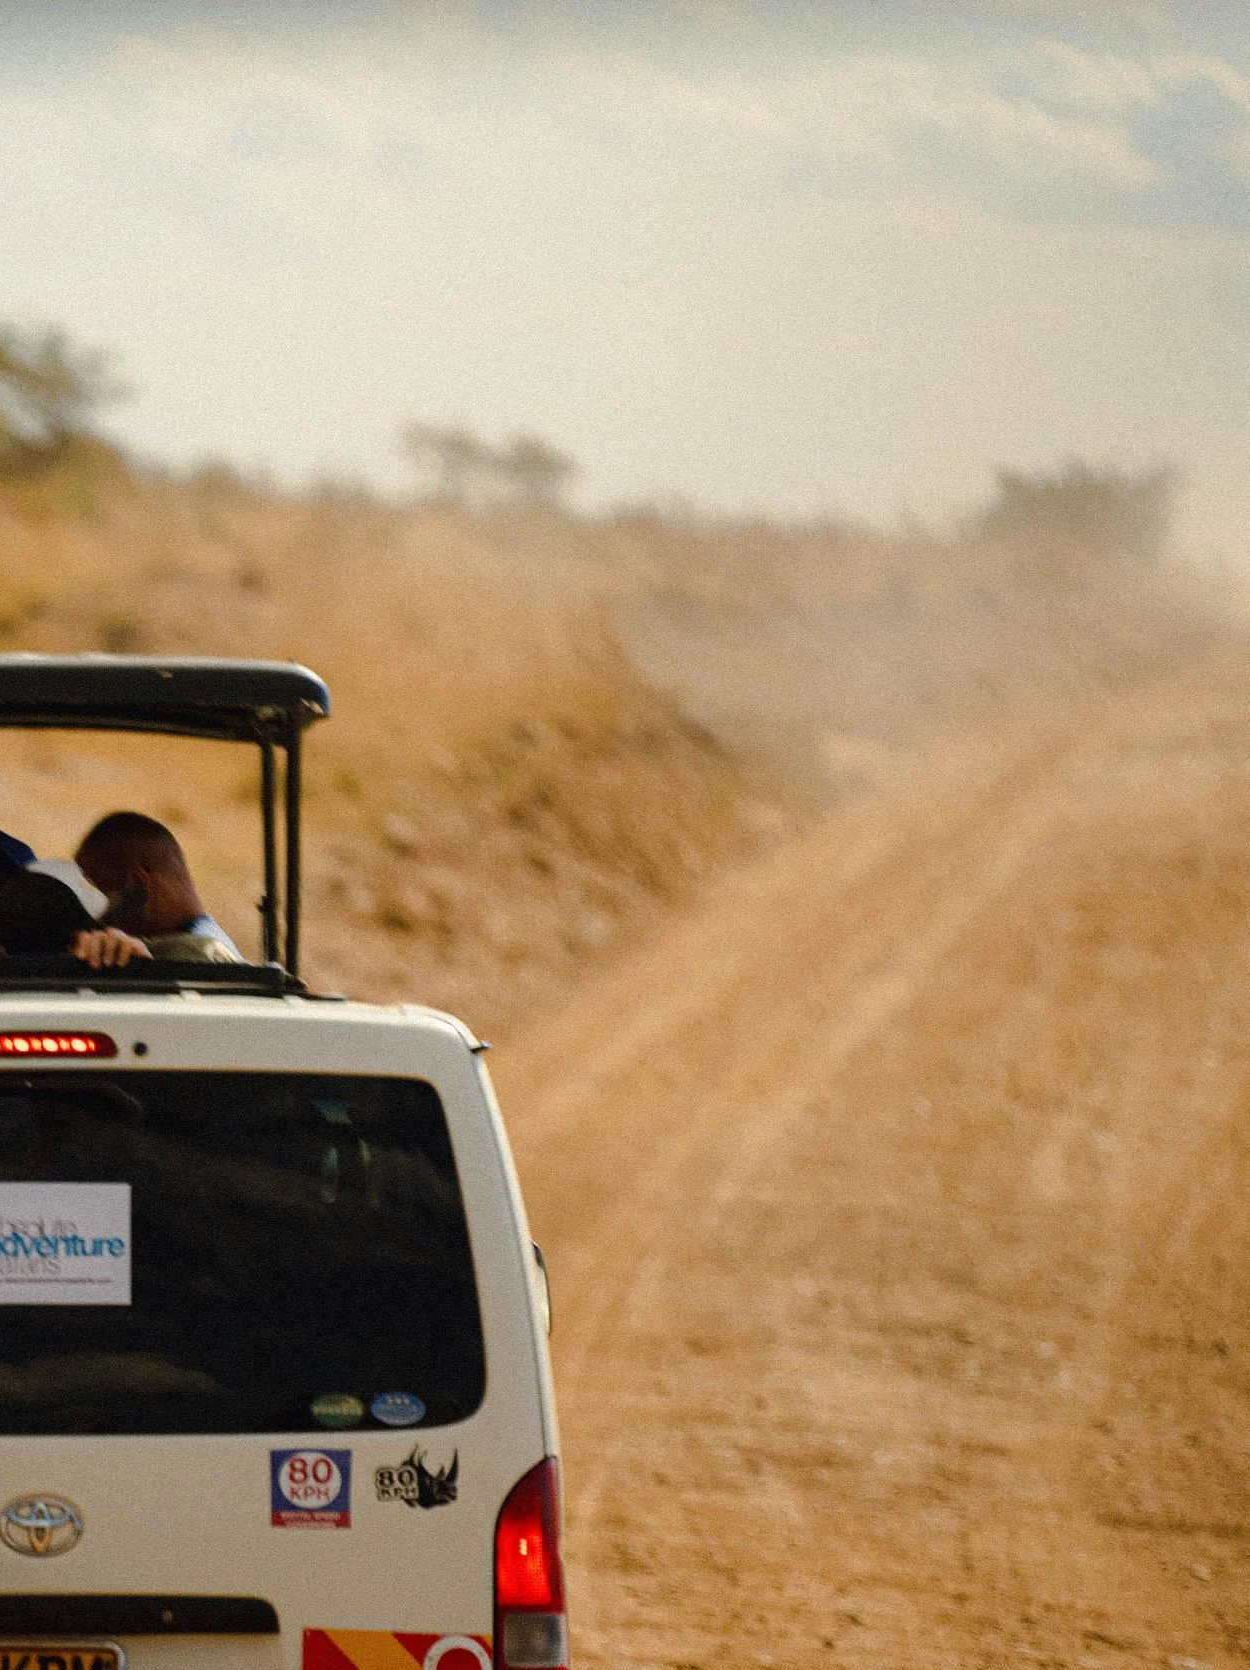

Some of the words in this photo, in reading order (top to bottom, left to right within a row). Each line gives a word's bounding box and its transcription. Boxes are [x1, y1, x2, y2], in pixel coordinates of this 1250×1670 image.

[288, 1456, 334, 1485] 80
[378, 1468, 415, 1487] 80
[289, 1486, 331, 1501] KPH
[379, 1486, 417, 1499] KPH
